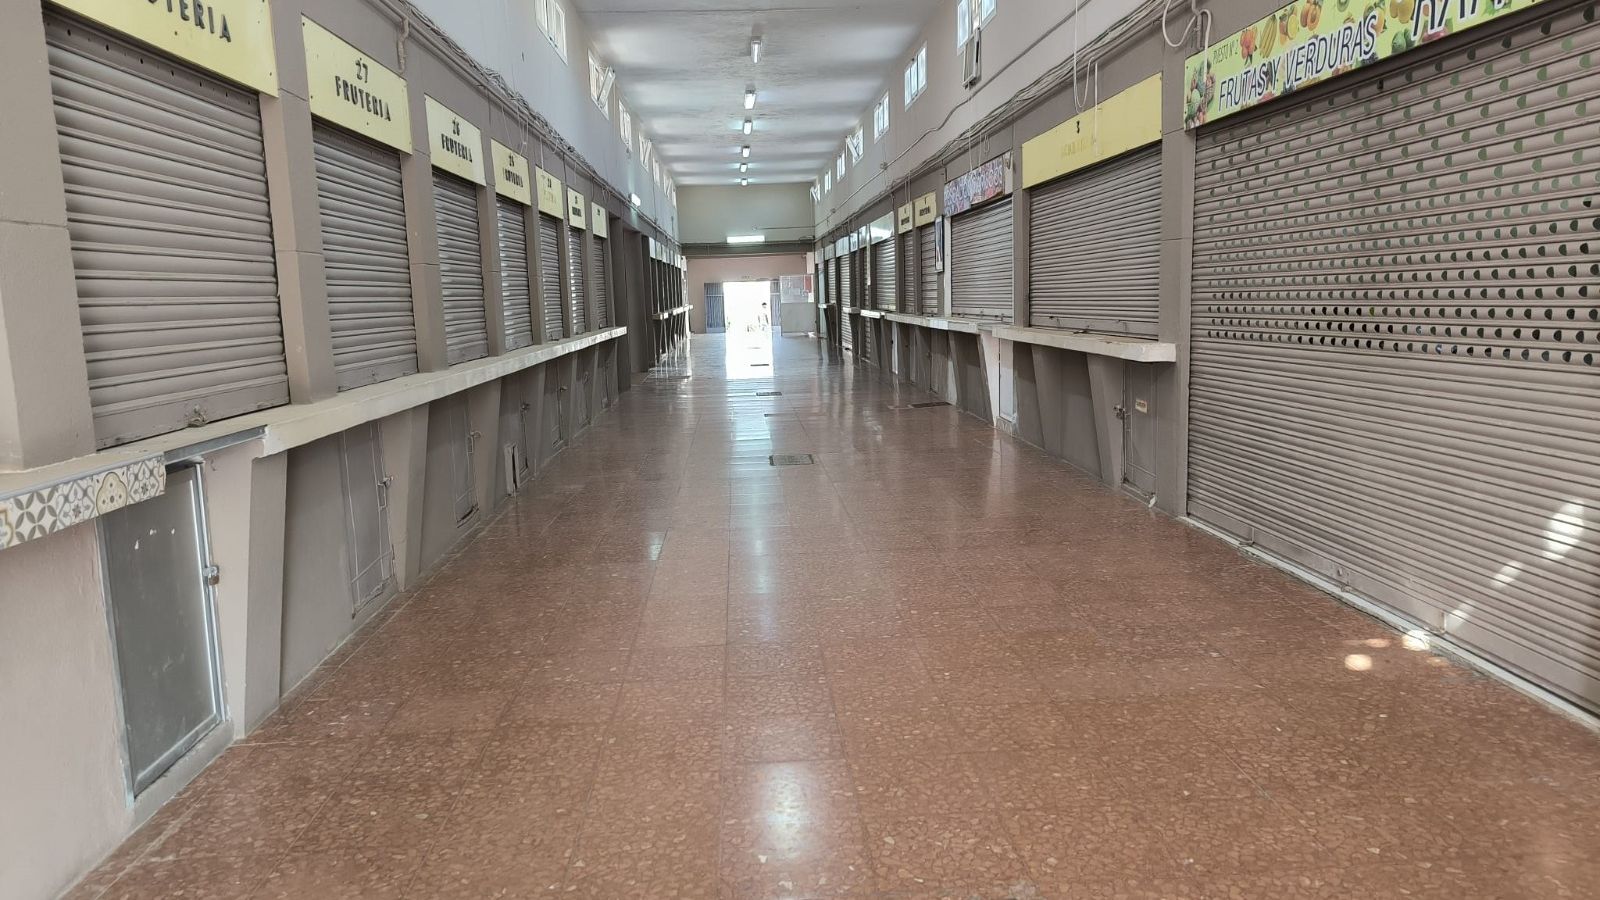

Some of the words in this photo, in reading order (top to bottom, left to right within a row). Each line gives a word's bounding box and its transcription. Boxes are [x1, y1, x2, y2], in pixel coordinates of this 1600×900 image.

[355, 59, 369, 84] 27
[1218, 63, 1267, 112] FRUTAS
[1272, 55, 1281, 91] Y
[1286, 14, 1377, 87] VERDURAS
[334, 75, 392, 122] FRUTERIA
[440, 133, 473, 164] FRUTERIA
